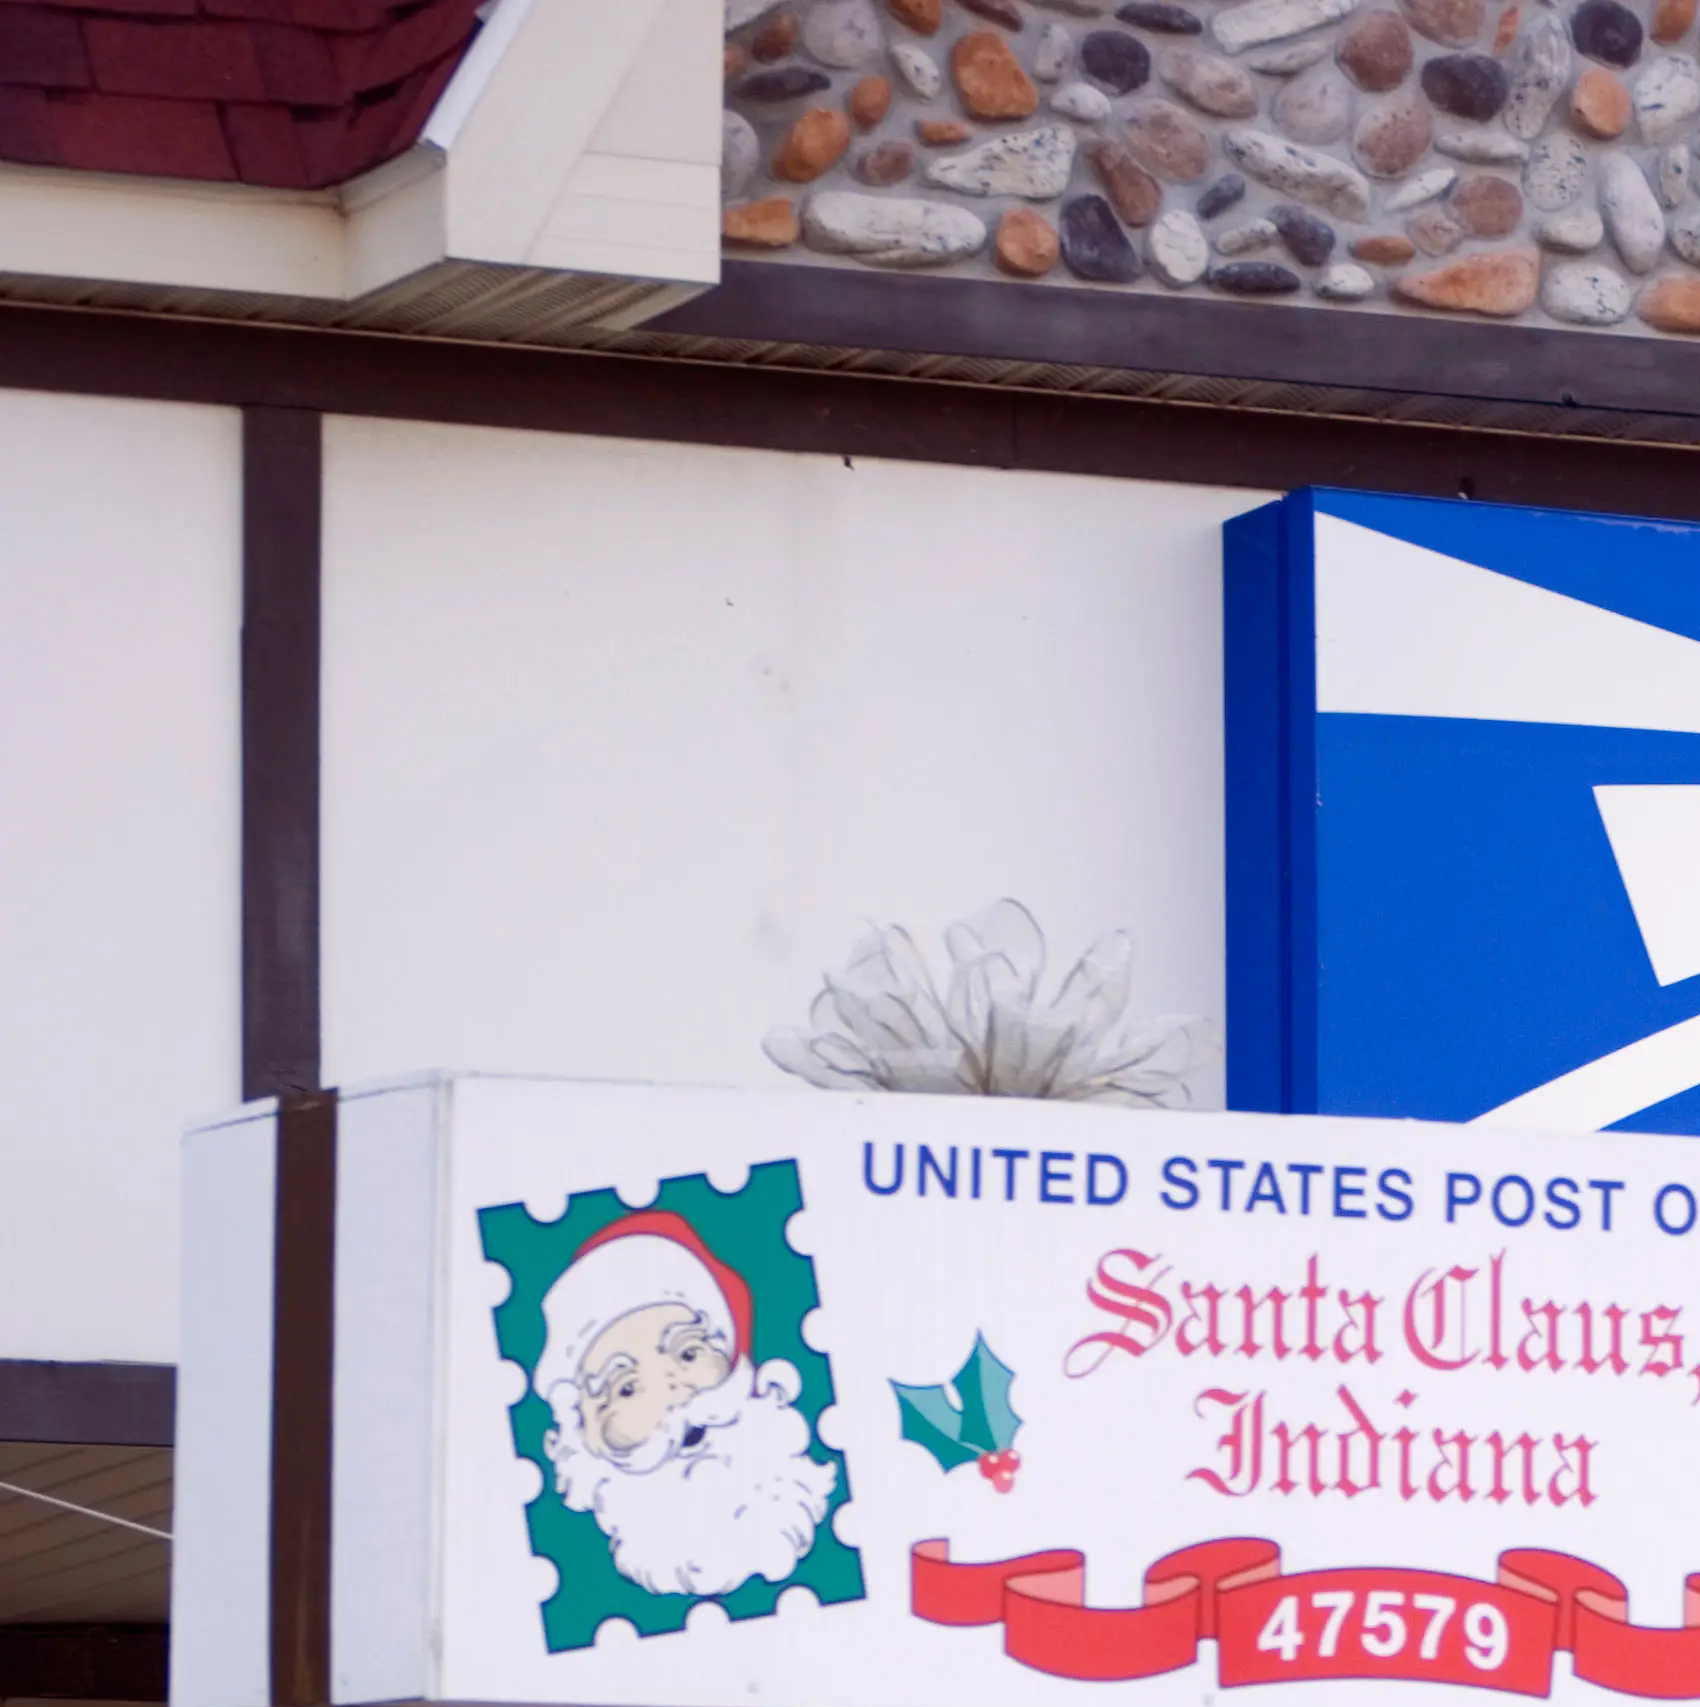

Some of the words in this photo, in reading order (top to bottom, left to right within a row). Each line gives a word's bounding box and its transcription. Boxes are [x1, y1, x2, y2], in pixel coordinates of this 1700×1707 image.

[861, 1140, 1131, 1210] UNITED
[1159, 1156, 1416, 1221] STATES
[1446, 1170, 1625, 1232] POST
[1062, 1246, 1382, 1380] Santa
[1185, 1383, 1600, 1510] Indiana
[1255, 1589, 1511, 1672] 47579
